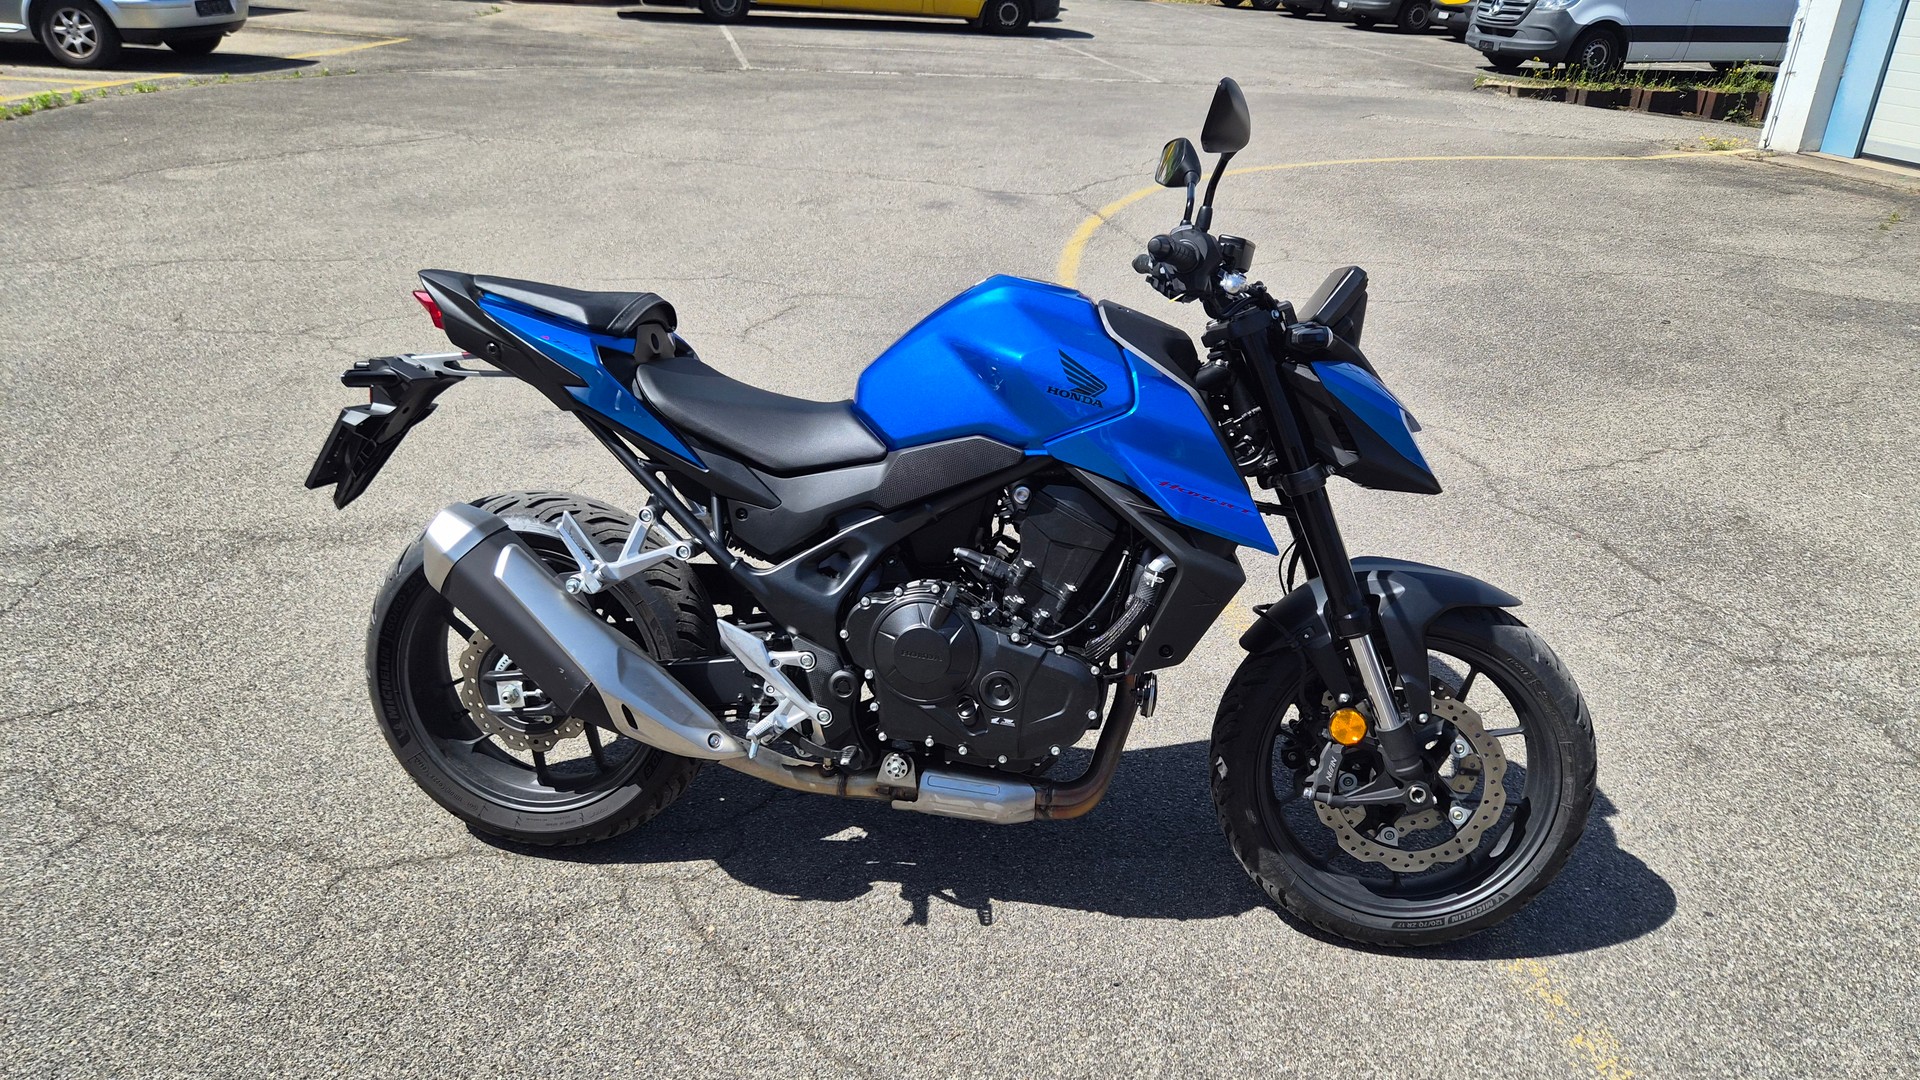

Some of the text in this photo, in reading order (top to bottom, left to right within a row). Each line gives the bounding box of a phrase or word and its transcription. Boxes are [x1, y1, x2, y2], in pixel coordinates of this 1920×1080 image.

[1046, 385, 1103, 408] HONDA
[901, 650, 944, 662] HONDA
[381, 646, 398, 719] MICHELIN
[1451, 901, 1493, 922] MICHELIN
[1418, 919, 1443, 928] 120/70
